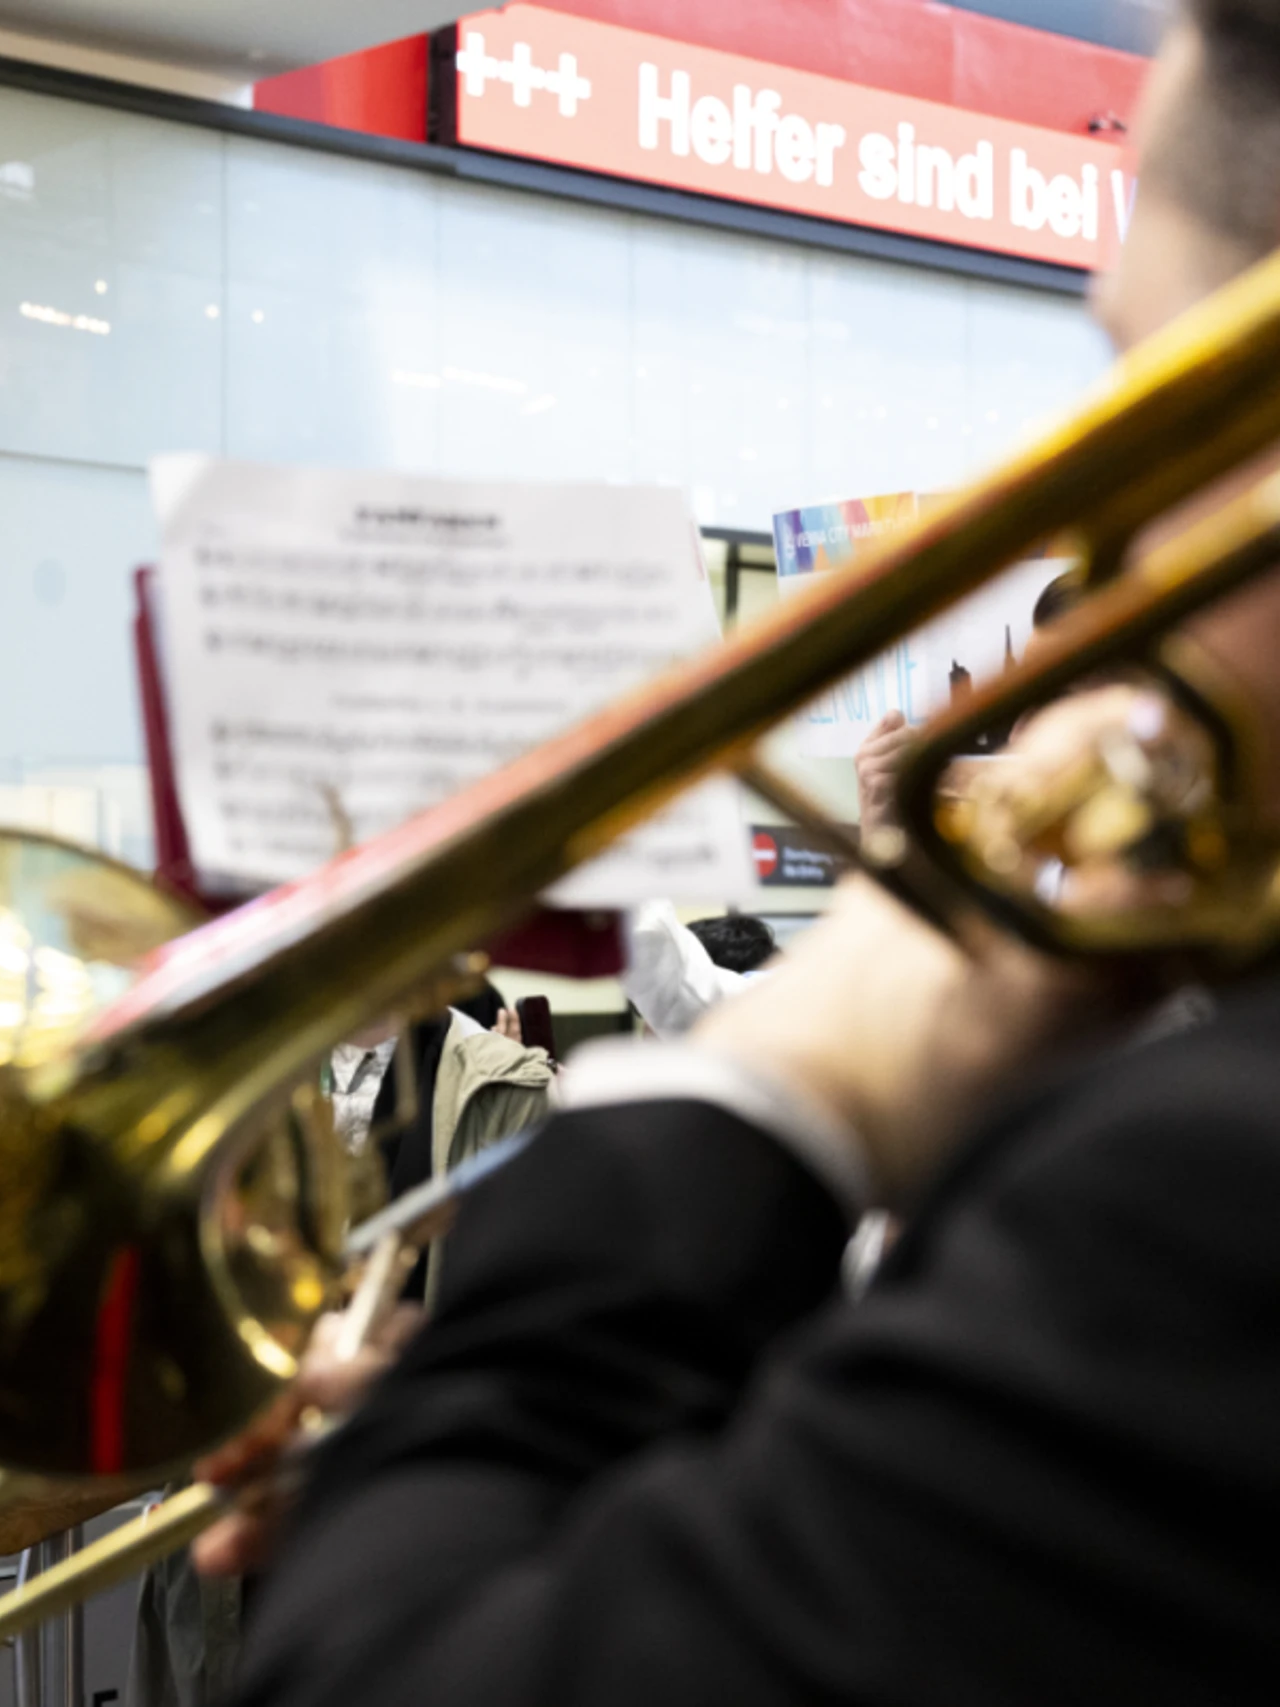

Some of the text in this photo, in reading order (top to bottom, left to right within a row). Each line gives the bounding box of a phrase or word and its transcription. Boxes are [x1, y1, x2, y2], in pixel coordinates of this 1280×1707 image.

[638, 60, 847, 188] Helfer
[857, 120, 993, 221] sind
[1009, 147, 1099, 242] bei
